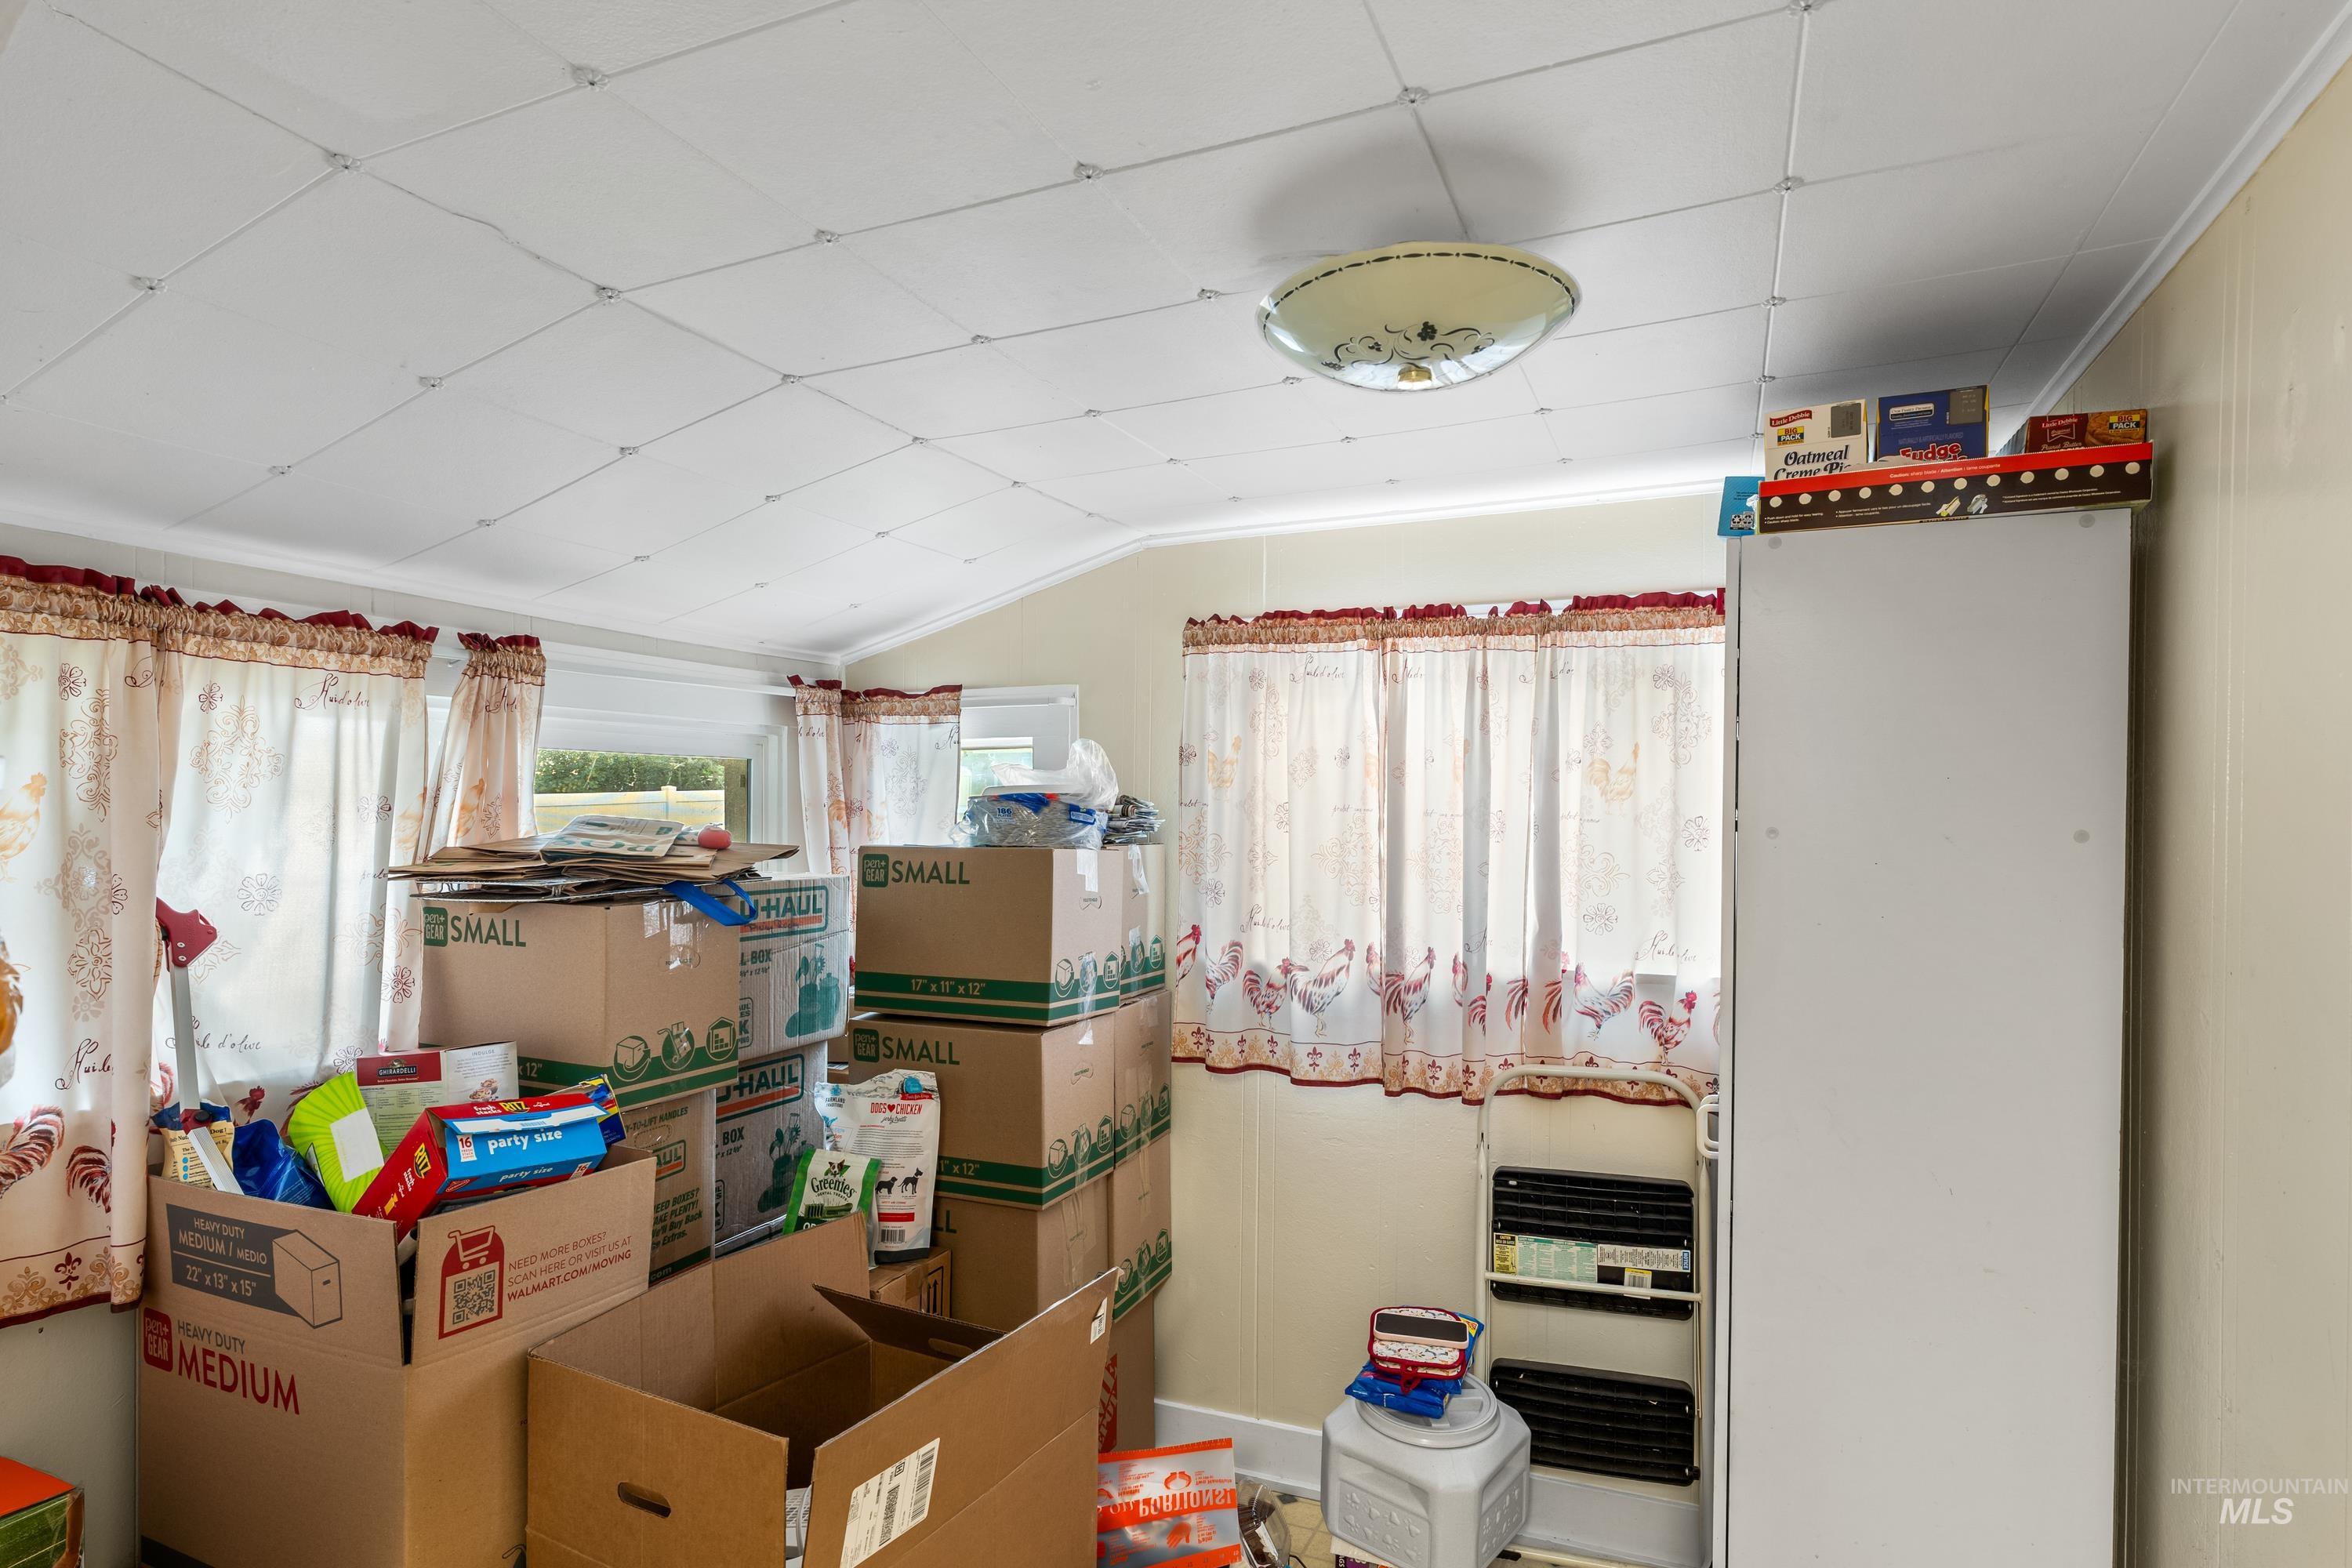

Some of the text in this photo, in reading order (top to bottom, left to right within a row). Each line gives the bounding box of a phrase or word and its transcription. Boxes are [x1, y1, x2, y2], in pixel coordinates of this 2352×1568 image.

[1772, 412, 1810, 426] Little Debbie
[2058, 417, 2078, 426] Debbie
[1784, 445, 1849, 466] Oatmeal
[1900, 442, 1962, 461] Fudge
[1774, 461, 1852, 481] Creme Pi
[866, 869, 884, 882] GEAR
[891, 860, 970, 884] SMALL
[740, 894, 822, 921] U-HAUL
[426, 924, 445, 940] GEAR
[451, 915, 526, 947] SMALL
[750, 949, 772, 964] BOX
[911, 978, 985, 995] 17" x 11" x 12"
[858, 1043, 876, 1057] GEAR
[882, 1036, 960, 1065] SMALL
[379, 1067, 416, 1076] GHIRARDELLI
[526, 1062, 543, 1077] 12"
[499, 1101, 531, 1112] RITZ
[659, 1106, 688, 1123] HANDLES
[870, 1102, 922, 1114] DOGS CHICKEN
[459, 1137, 472, 1149] 16
[488, 1128, 562, 1155] party size
[722, 1127, 744, 1146] BOX
[414, 1142, 432, 1179] RITZ
[953, 1165, 960, 1174] x
[962, 1163, 979, 1175] 12"
[499, 1166, 554, 1182] party size
[672, 1188, 700, 1205] BOXES?
[811, 1177, 855, 1198] Greenies
[653, 1200, 698, 1225] AKE PLENTY!
[194, 1218, 245, 1240] HEAVY DUTY
[179, 1229, 225, 1255] MEDIUM
[237, 1248, 267, 1265] MEDIO
[509, 1232, 607, 1272] NEED MORE BOXES?
[507, 1236, 632, 1287] SCAN HERE OR VISIT US AT
[187, 1265, 256, 1297] 22" x 13" x 15"
[507, 1250, 632, 1302] WALMART.COM/MOVING
[145, 1317, 169, 1338] pen+
[147, 1334, 169, 1362] GEAR
[177, 1320, 245, 1356] HEAVY DUTY
[178, 1340, 299, 1415] MEDIUM
